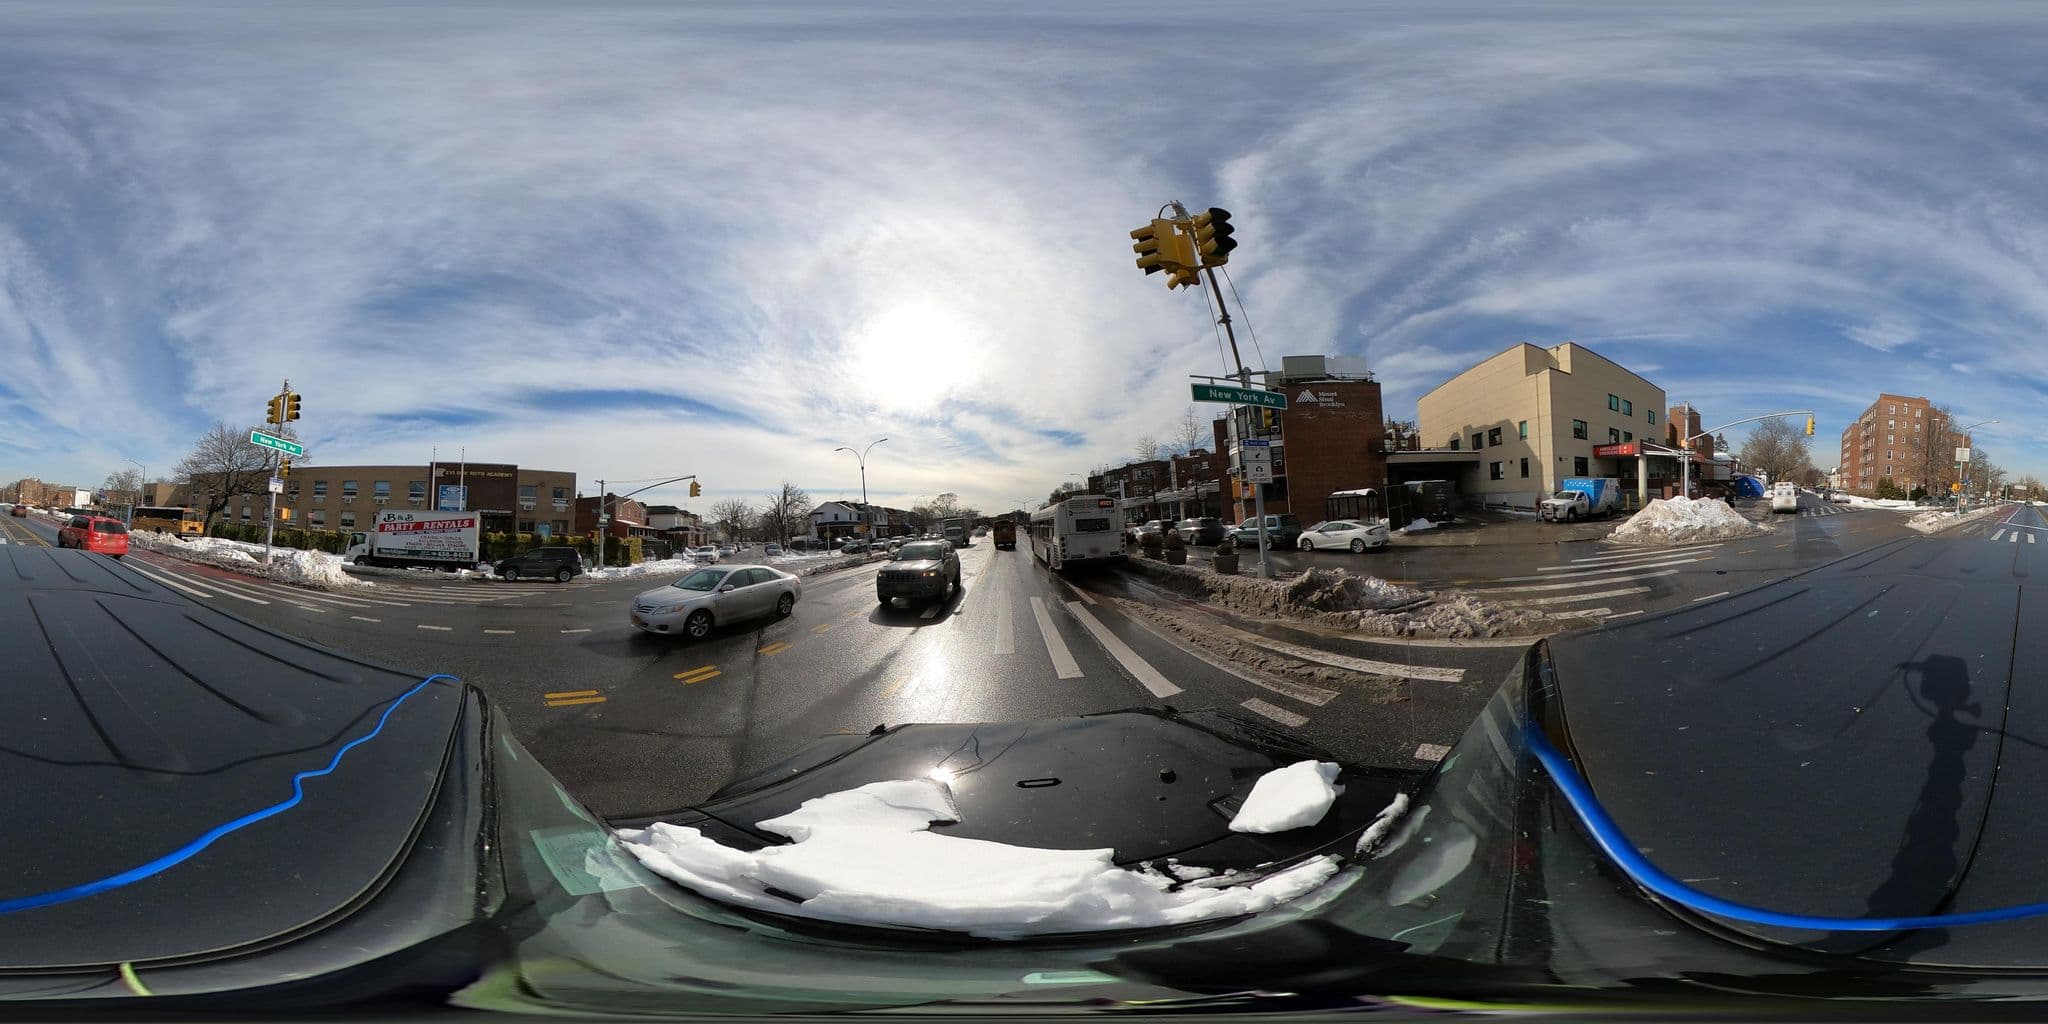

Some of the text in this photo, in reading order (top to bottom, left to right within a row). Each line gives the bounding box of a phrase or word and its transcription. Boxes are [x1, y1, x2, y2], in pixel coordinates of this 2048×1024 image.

[1209, 388, 1275, 404] New York Av
[260, 436, 273, 445] New
[275, 440, 287, 449] York
[383, 513, 396, 522] B
[384, 522, 416, 532] PARTY
[423, 519, 470, 530] RENTALS
